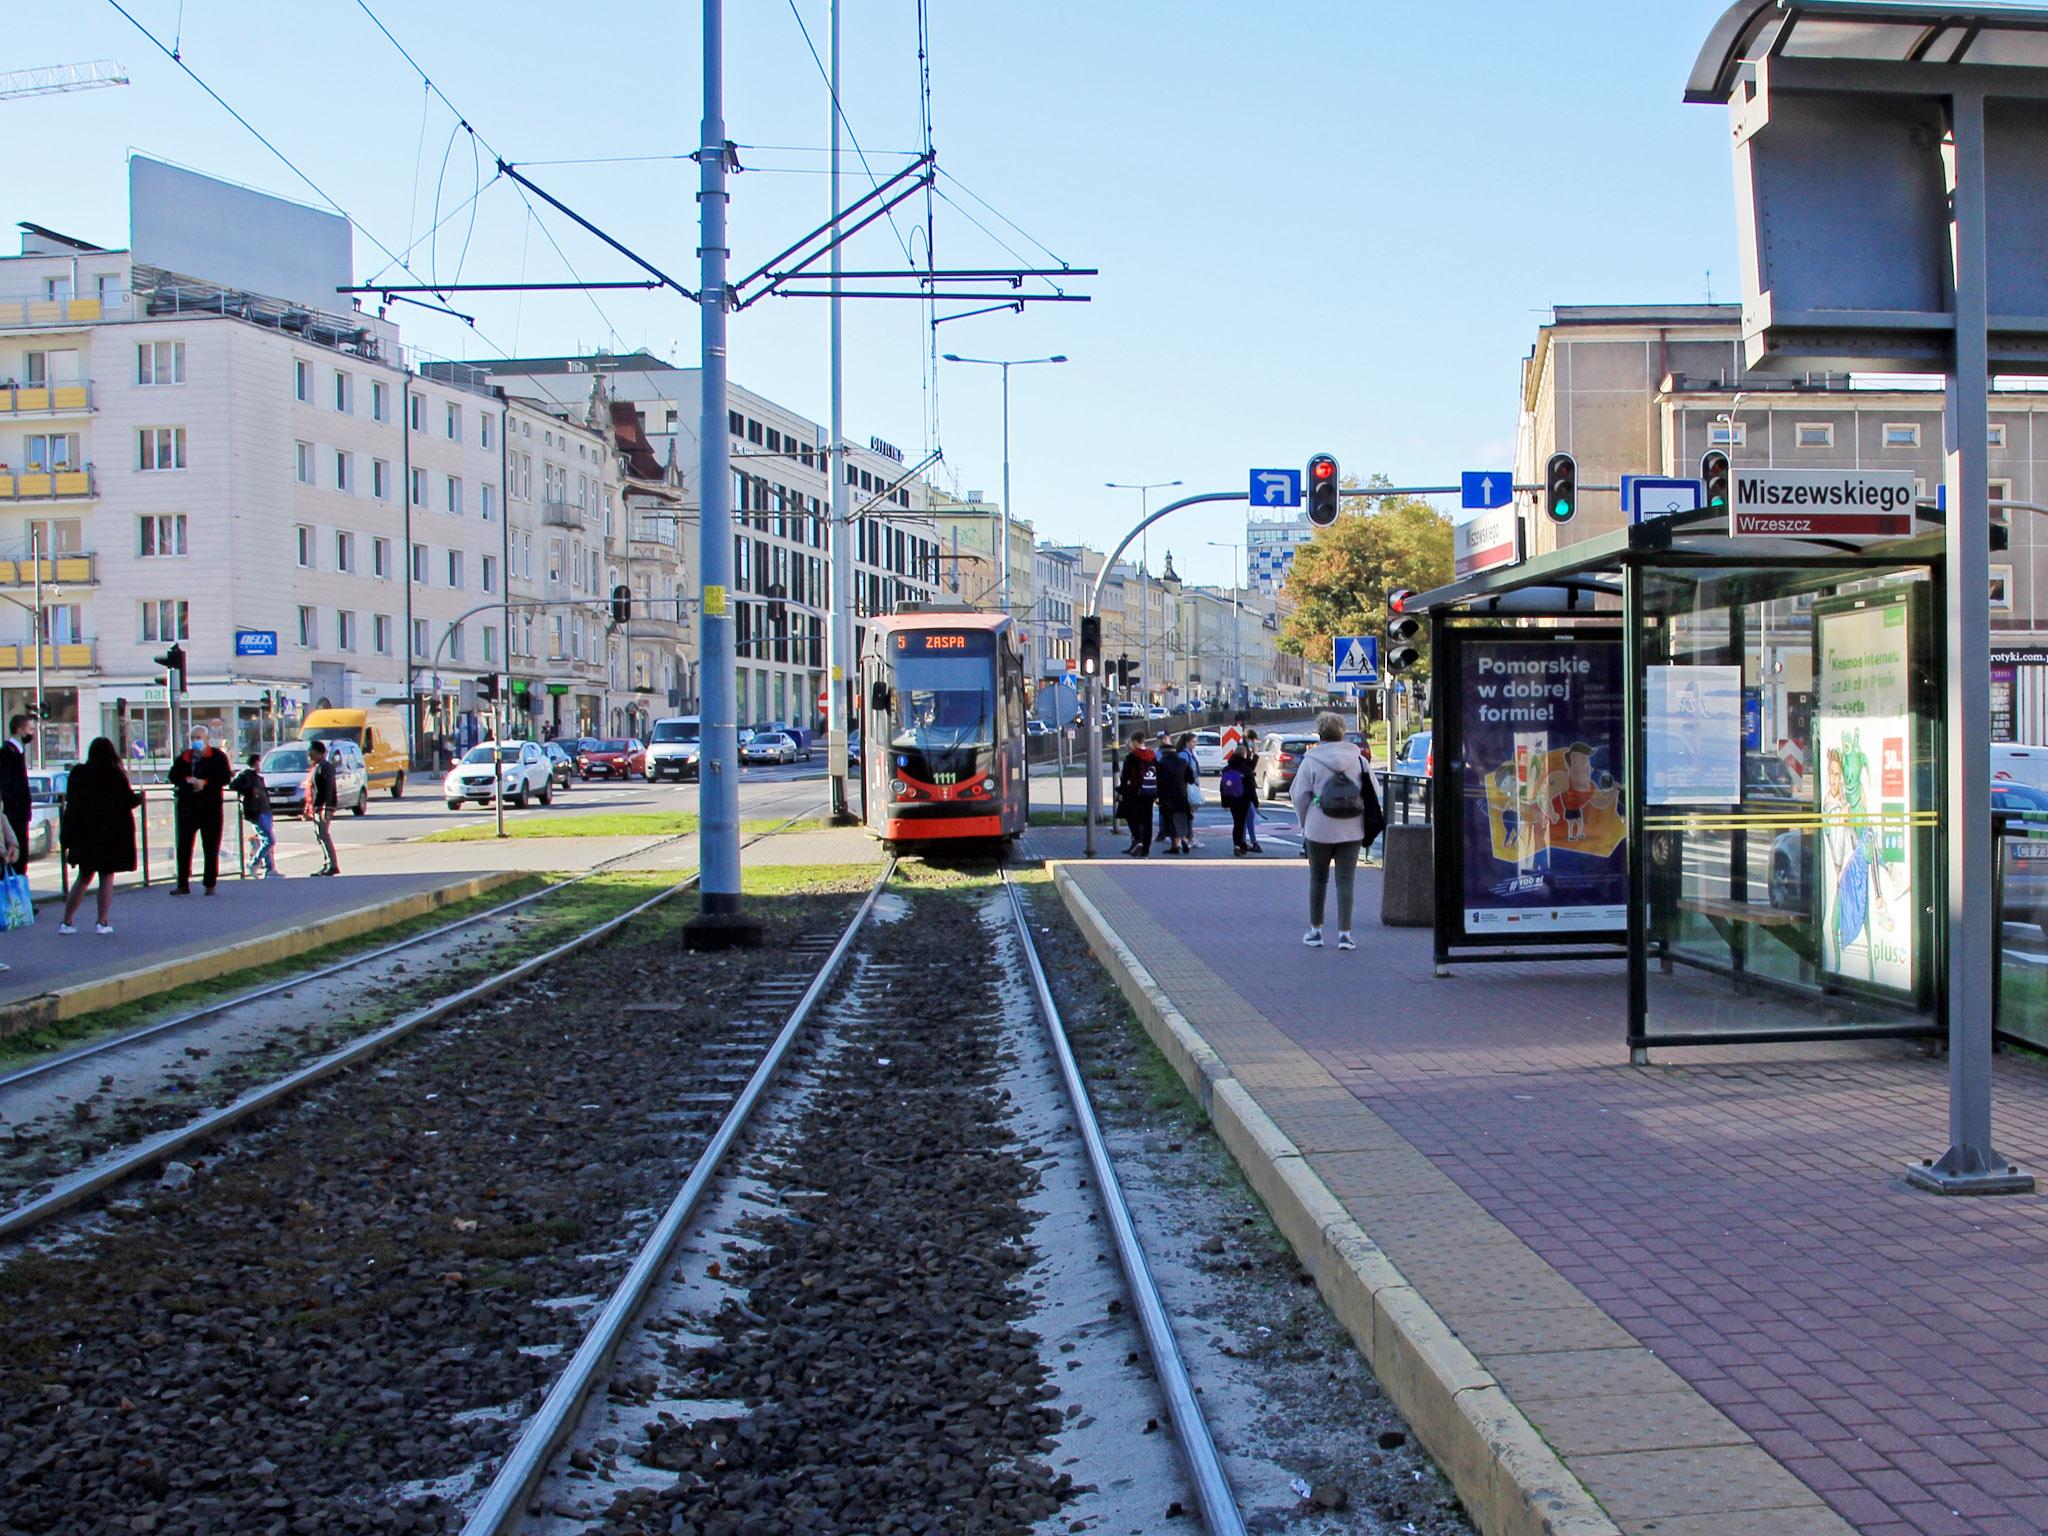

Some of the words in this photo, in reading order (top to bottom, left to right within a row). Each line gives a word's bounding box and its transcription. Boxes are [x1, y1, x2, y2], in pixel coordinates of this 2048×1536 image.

[1738, 479, 1910, 512] Miszewskiego
[1739, 516, 1811, 531] Wrzeszcz
[240, 635, 272, 645] DELTA
[897, 636, 906, 649] 5
[925, 636, 965, 649] ZASPA
[1478, 656, 1591, 675] Pomorskie
[1478, 685, 1497, 698] w
[1502, 679, 1571, 701] dobrej
[1479, 704, 1554, 721] formie!
[933, 772, 957, 785] 1111
[2019, 845, 2033, 857] CT
[1873, 938, 1898, 966] plus
